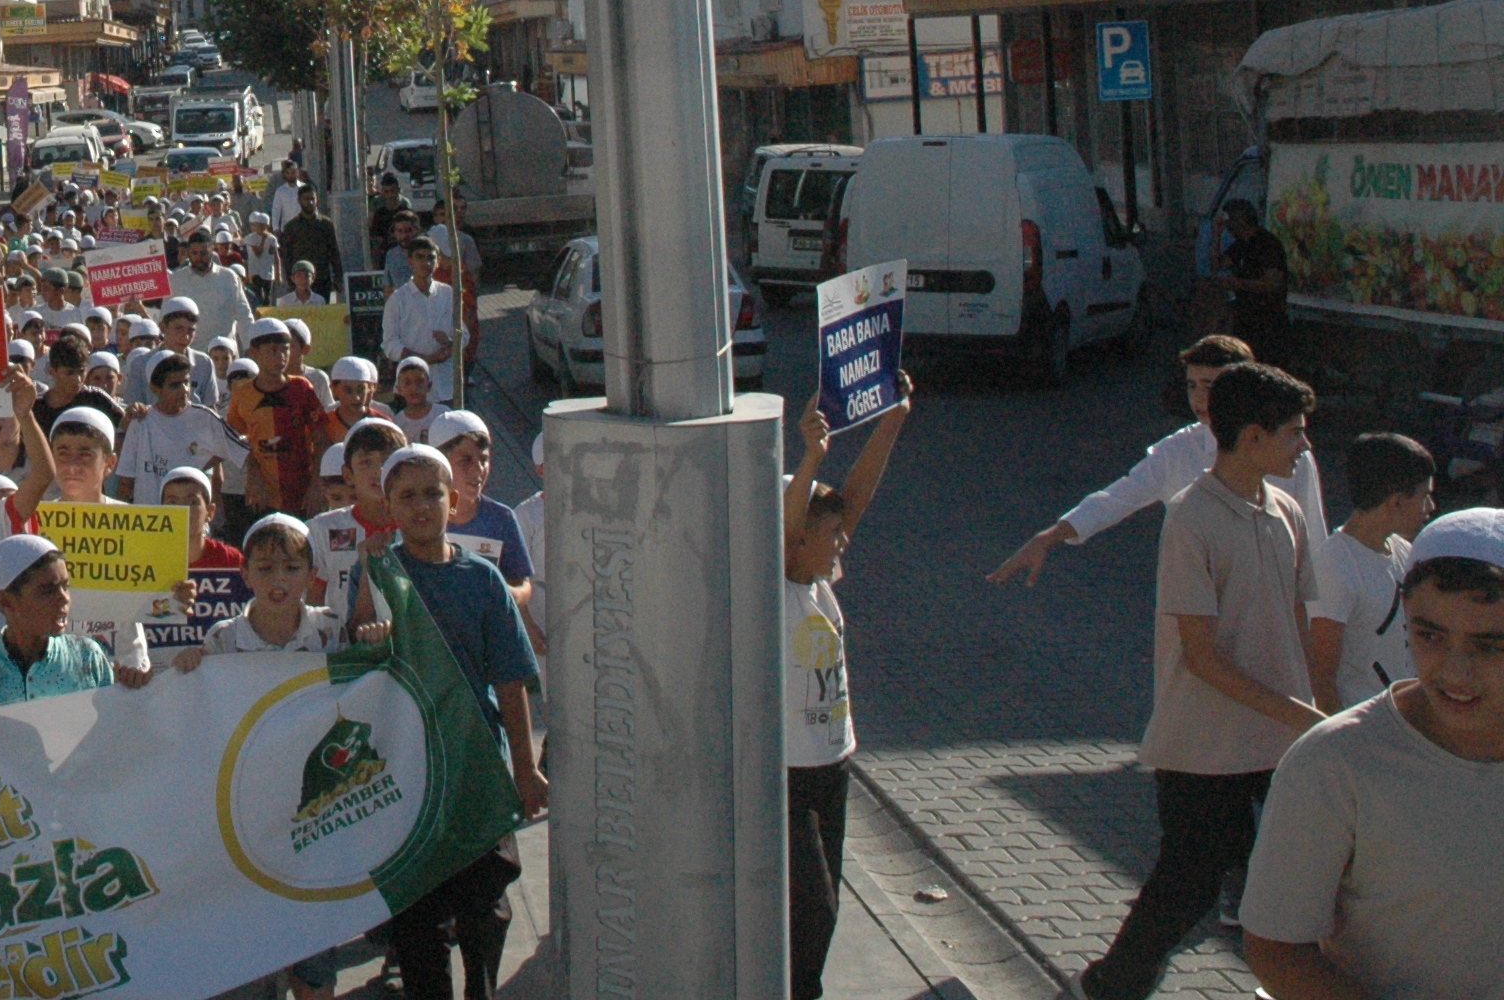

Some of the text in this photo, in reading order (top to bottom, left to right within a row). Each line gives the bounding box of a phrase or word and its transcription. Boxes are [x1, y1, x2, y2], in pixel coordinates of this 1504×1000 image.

[1103, 27, 1131, 69] P
[91, 268, 121, 281] NAMAZ
[826, 325, 856, 357] BABA
[856, 312, 891, 344] BANA
[839, 350, 880, 389] NAMAZI
[846, 384, 882, 420] ÖĞRET
[82, 511, 173, 532] NAMAZA
[63, 534, 124, 556] HAYDİ
[67, 562, 156, 587] RTULUŞA
[291, 773, 395, 841] PEYGAMBER
[292, 788, 403, 854] SEVDALILARI
